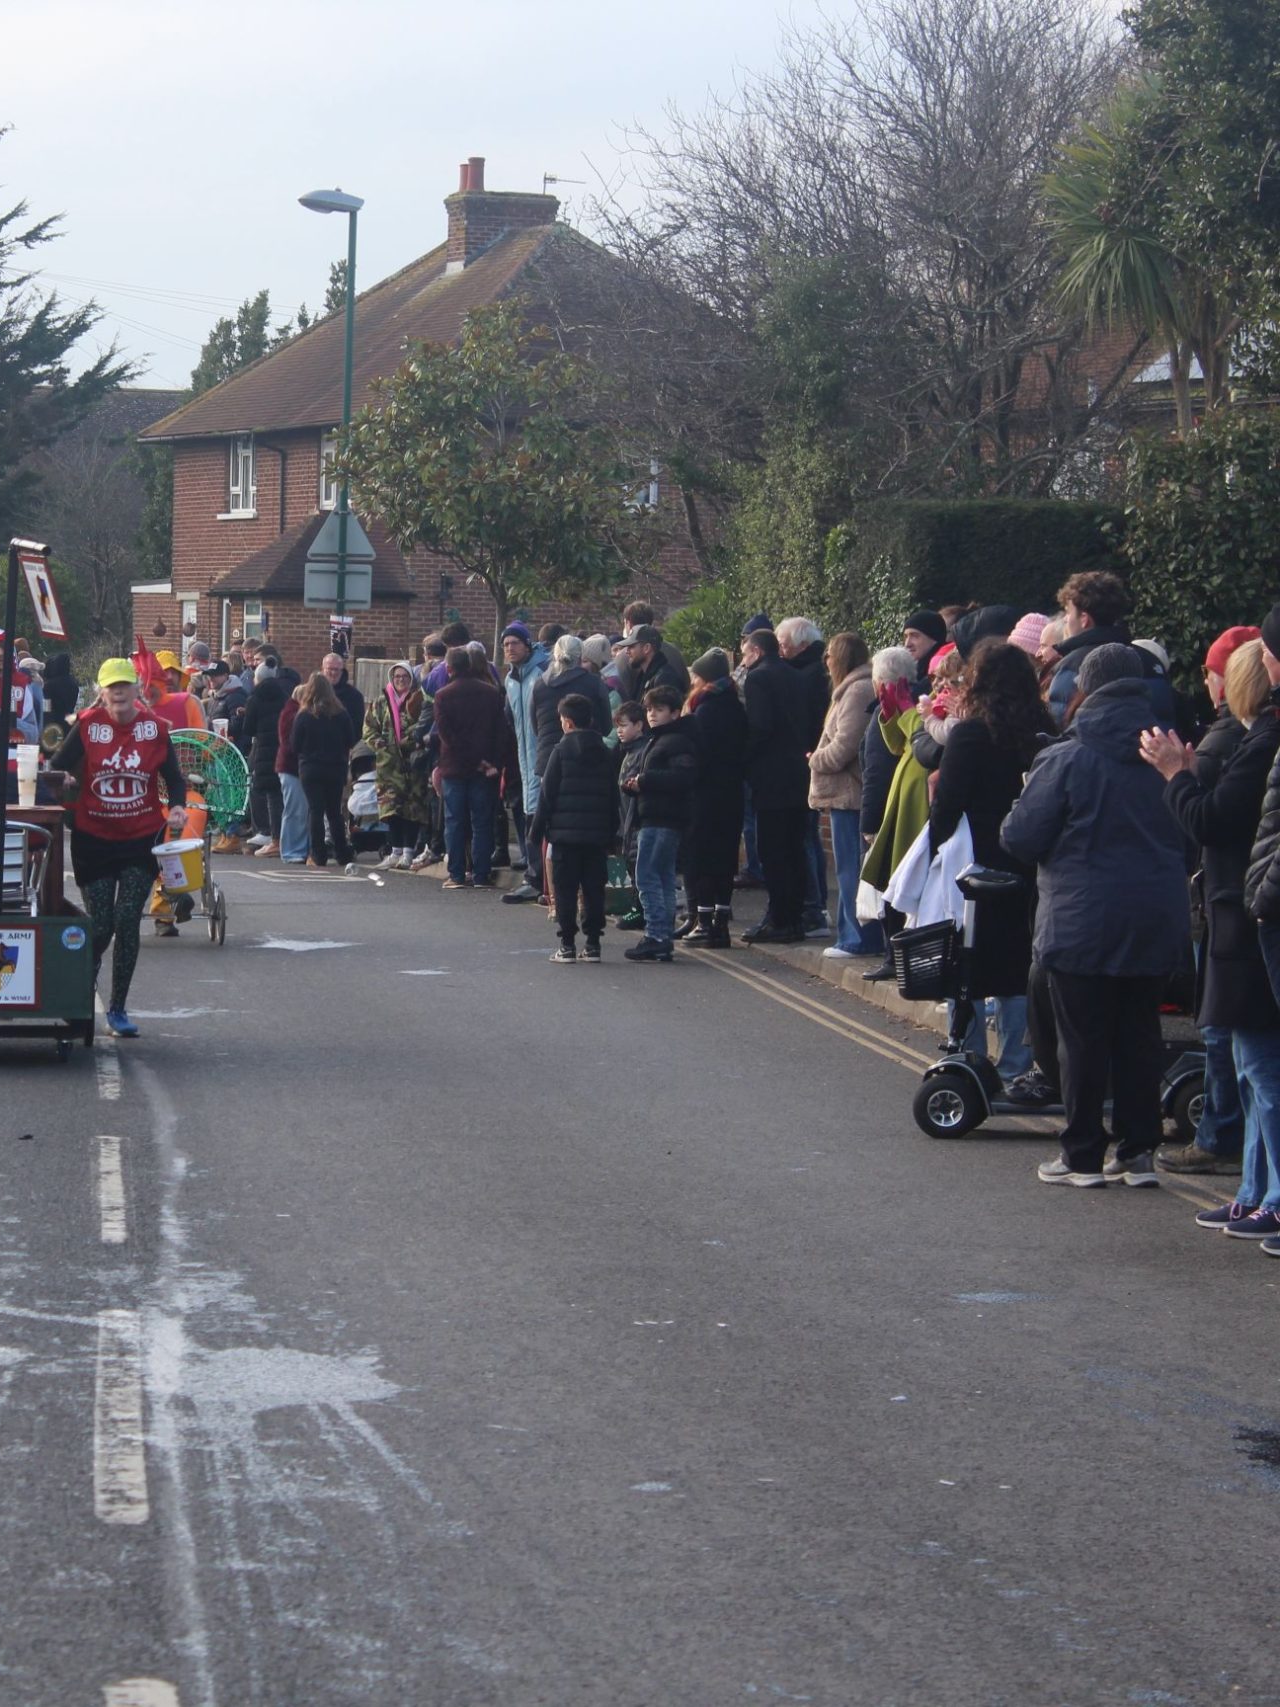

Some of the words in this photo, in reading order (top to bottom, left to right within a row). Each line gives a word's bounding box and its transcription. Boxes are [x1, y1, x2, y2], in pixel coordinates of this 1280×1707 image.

[88, 722, 114, 744] 18
[131, 721, 158, 743] 18
[100, 778, 144, 796] KIA
[101, 798, 144, 811] NEWBARN
[7, 932, 32, 941] ARMS
